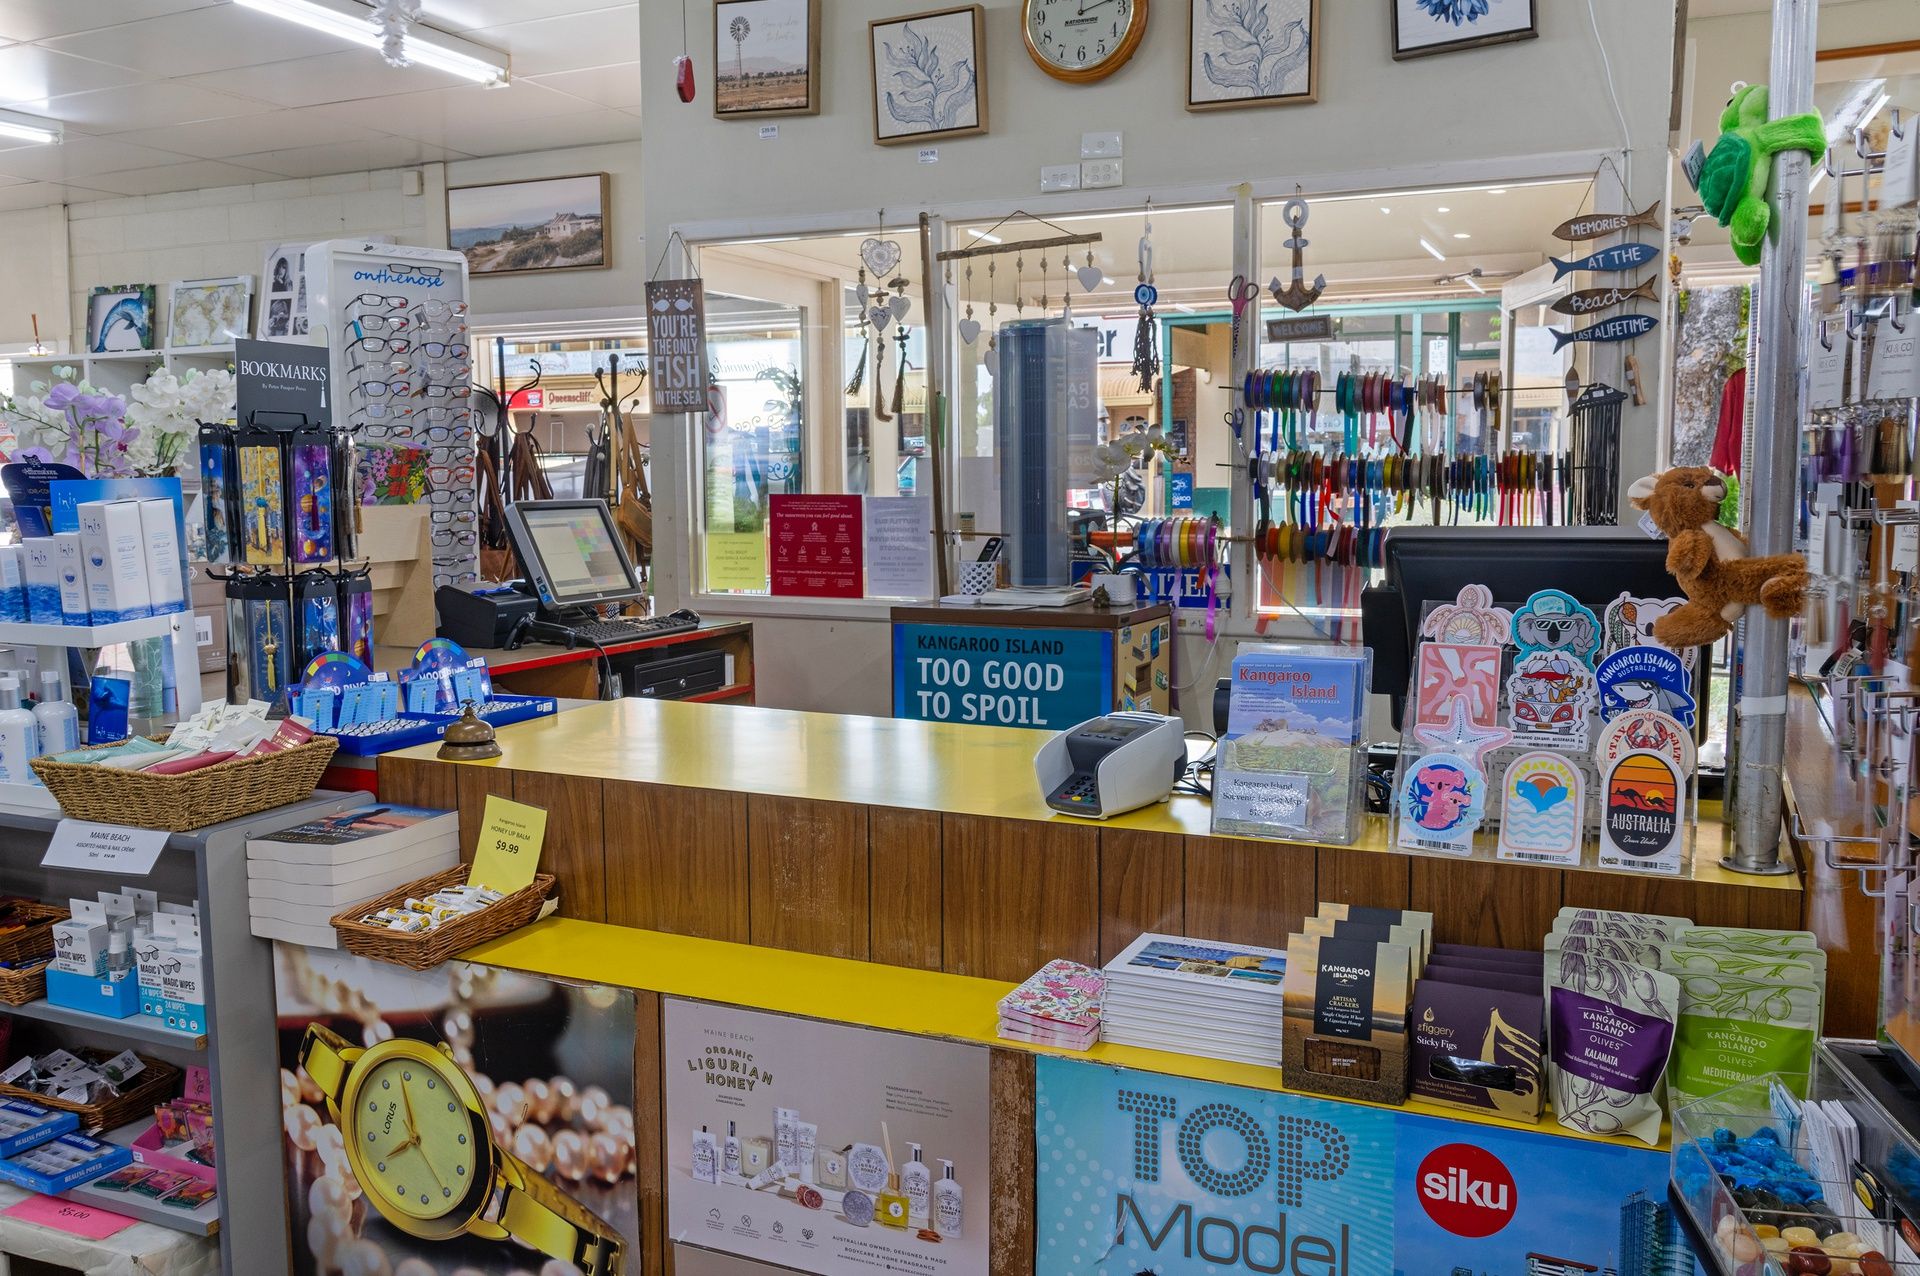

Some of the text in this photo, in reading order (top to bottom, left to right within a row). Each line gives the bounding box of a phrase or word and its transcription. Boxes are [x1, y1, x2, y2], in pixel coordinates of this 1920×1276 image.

[1117, 0, 1127, 16] 3
[1037, 10, 1046, 26] 9
[1064, 16, 1098, 27] NATIONWIDE
[1043, 29, 1052, 45] 8
[1109, 21, 1118, 38] 4
[1058, 43, 1066, 59] 7
[1077, 45, 1086, 61] 6
[1096, 39, 1106, 55] 5
[1570, 216, 1628, 236] MEMORIES
[1588, 247, 1641, 269] AT THE
[1570, 288, 1637, 312] Beach
[652, 315, 697, 338] YOU'RE
[1272, 321, 1326, 335] WELCOME
[1573, 317, 1650, 341] LAST A LIFETIME
[653, 338, 698, 355] THE ONLY
[241, 360, 327, 382] BOOKMARKS
[653, 355, 700, 388] FISH
[549, 391, 592, 405] Queenscliff
[655, 390, 702, 405] IN THE SEA
[58, 492, 77, 510] inis
[84, 518, 101, 536] inis
[30, 550, 47, 564] inis
[59, 543, 74, 558] inis
[917, 635, 1064, 655] KANGAROO ISLAND
[917, 657, 1064, 692] TOO GOOD
[1240, 668, 1312, 685] Kangaroo
[1600, 652, 1678, 684] KANGAROO ISLAND
[1618, 665, 1657, 679] AUSTRALIA
[1291, 684, 1338, 699] Island
[917, 690, 1048, 726] TO SPOIL
[1608, 726, 1627, 760] STAY
[1611, 813, 1671, 835] AUSTRALIA
[89, 831, 131, 842] MAINE BEACH
[491, 825, 508, 834] HONEY
[516, 832, 531, 841] BALM
[495, 839, 519, 854] $9.99
[57, 950, 87, 963] MAGIC WIPES
[140, 963, 156, 975] MAGIC
[1321, 964, 1371, 978] KANGAROO
[1333, 973, 1358, 981] ISLAND
[163, 976, 196, 991] MAGIC WIPES
[1329, 1001, 1360, 1009] CRACKERS
[1422, 1022, 1455, 1038] figgery
[1583, 1011, 1636, 1034] KANGAROO
[1592, 1021, 1624, 1038] ISLAND
[704, 1028, 755, 1043] MAINE BEACH
[1416, 1036, 1457, 1051] Sticky Figs
[1706, 1031, 1768, 1049] KANGAROO
[705, 1045, 754, 1063] ORGANIC
[1718, 1040, 1755, 1054] ISLAND
[1584, 1047, 1619, 1067] KALAMATA
[687, 1057, 774, 1086] LIGURIAN
[705, 1072, 756, 1092] HONEY
[383, 1101, 397, 1135] LORUS
[15, 1128, 51, 1147] HEALING POWER
[1117, 1088, 1351, 1208] TOP
[64, 1163, 102, 1183] HEALING POWER
[1423, 1167, 1509, 1212] siku
[58, 1207, 91, 1219] $5.00
[1116, 1194, 1350, 1276] Model
[832, 1235, 868, 1247] AUSTRALIAN
[869, 1243, 893, 1253] OWNED,
[893, 1248, 923, 1260] DESIGNED
[930, 1257, 948, 1265] MADE
[844, 1246, 875, 1258] BODYCARE
[882, 1255, 898, 1263] HOME
[900, 1259, 936, 1271] FRAGRANCE
